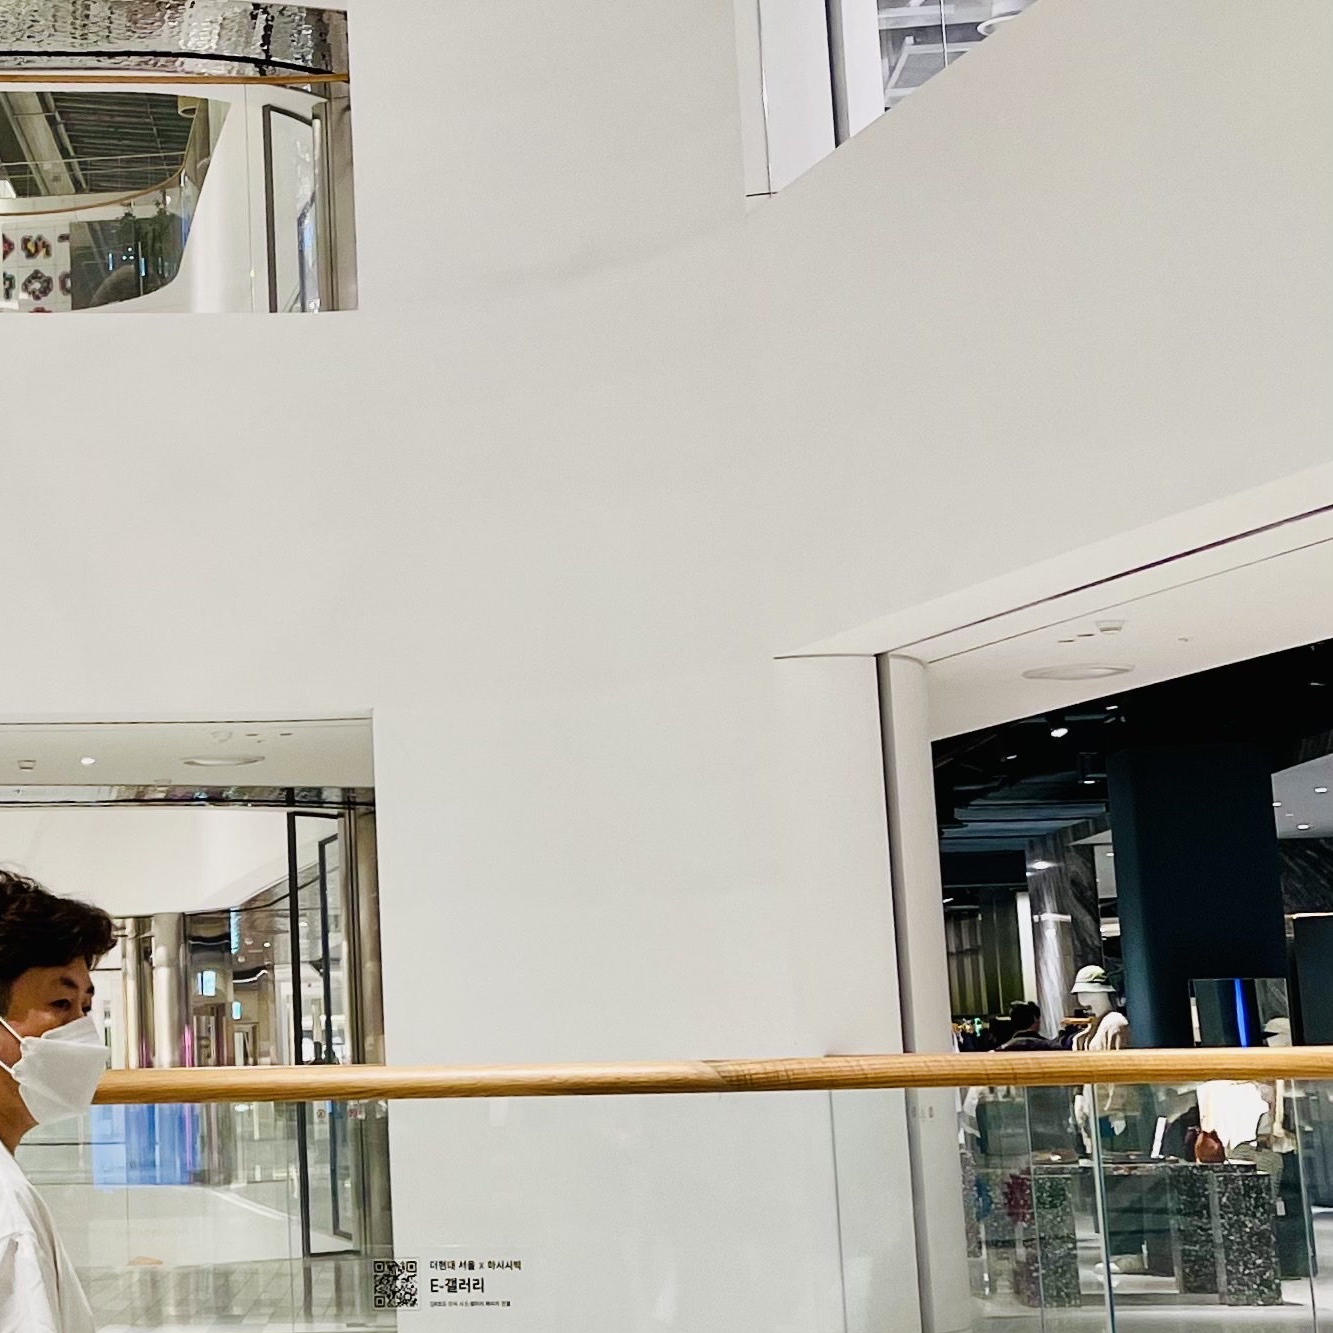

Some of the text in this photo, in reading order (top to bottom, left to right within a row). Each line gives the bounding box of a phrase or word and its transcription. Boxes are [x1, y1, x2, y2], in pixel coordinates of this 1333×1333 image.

[430, 1260, 455, 1271] 더현대
[458, 1260, 475, 1271] 서울
[430, 1278, 485, 1293] E-갤러리
